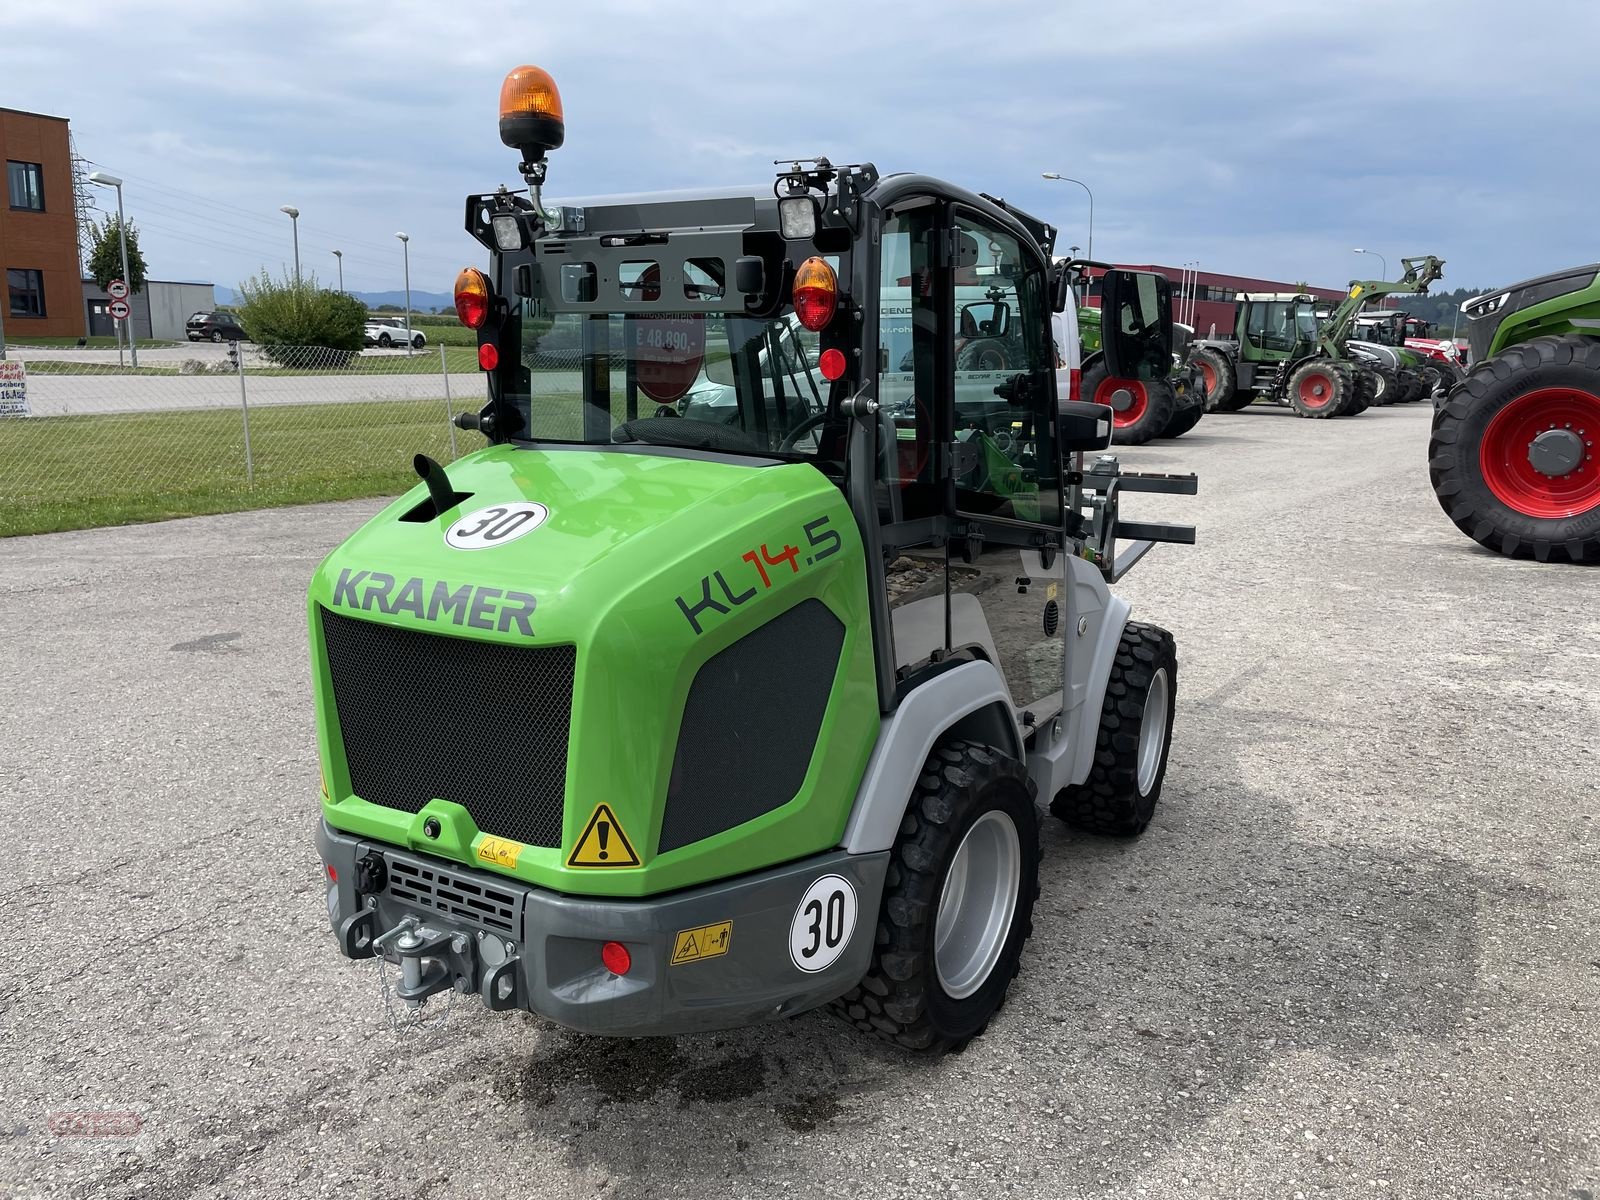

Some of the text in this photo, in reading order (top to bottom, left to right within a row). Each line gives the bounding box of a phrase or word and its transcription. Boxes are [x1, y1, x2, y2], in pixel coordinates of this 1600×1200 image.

[636, 328, 644, 345] €
[456, 507, 535, 541] 30
[333, 568, 537, 637] KRAMER
[674, 515, 842, 635] KL14.5
[802, 890, 845, 958] 30
